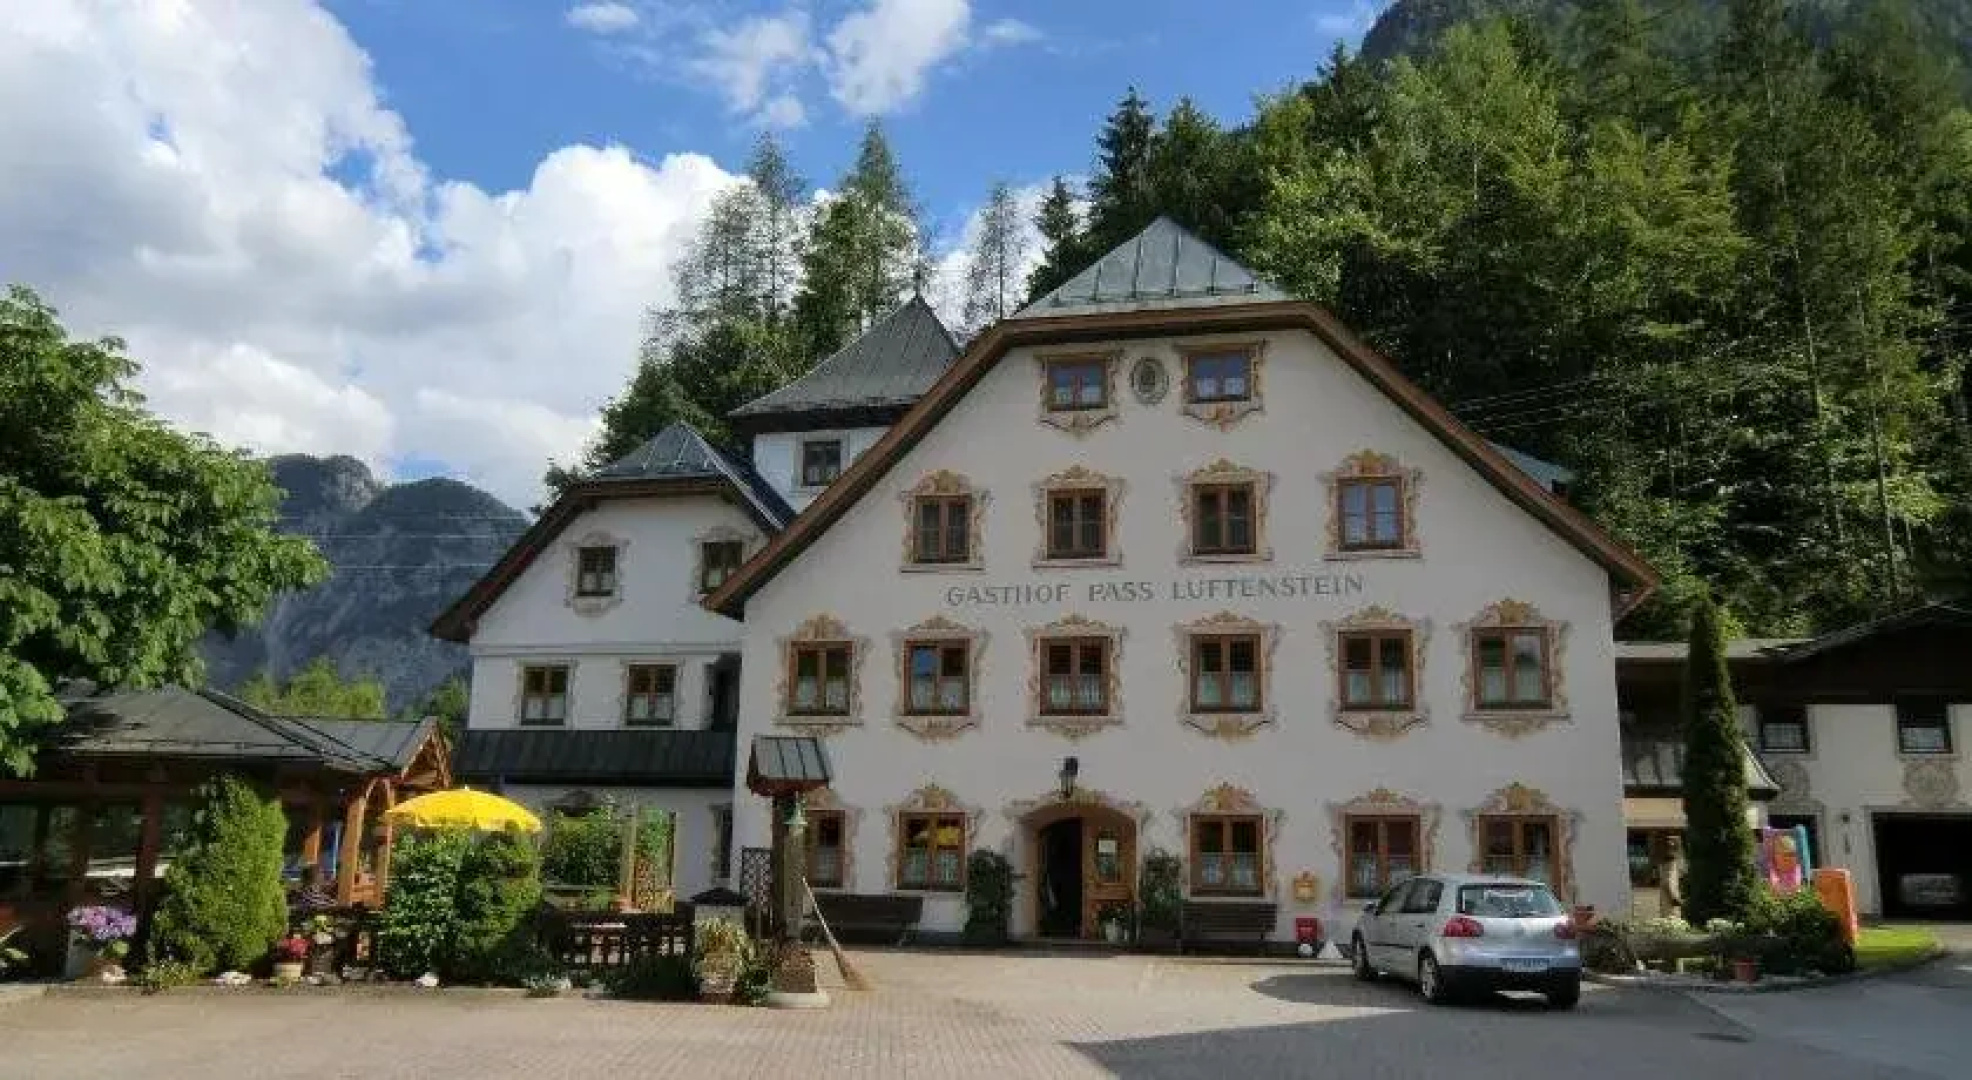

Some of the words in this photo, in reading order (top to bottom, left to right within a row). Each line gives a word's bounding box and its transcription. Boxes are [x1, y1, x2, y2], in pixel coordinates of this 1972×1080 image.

[946, 584, 1071, 606] GASTHOF
[1088, 581, 1154, 602] PASS
[1173, 575, 1364, 600] LUFTENSTEIN
